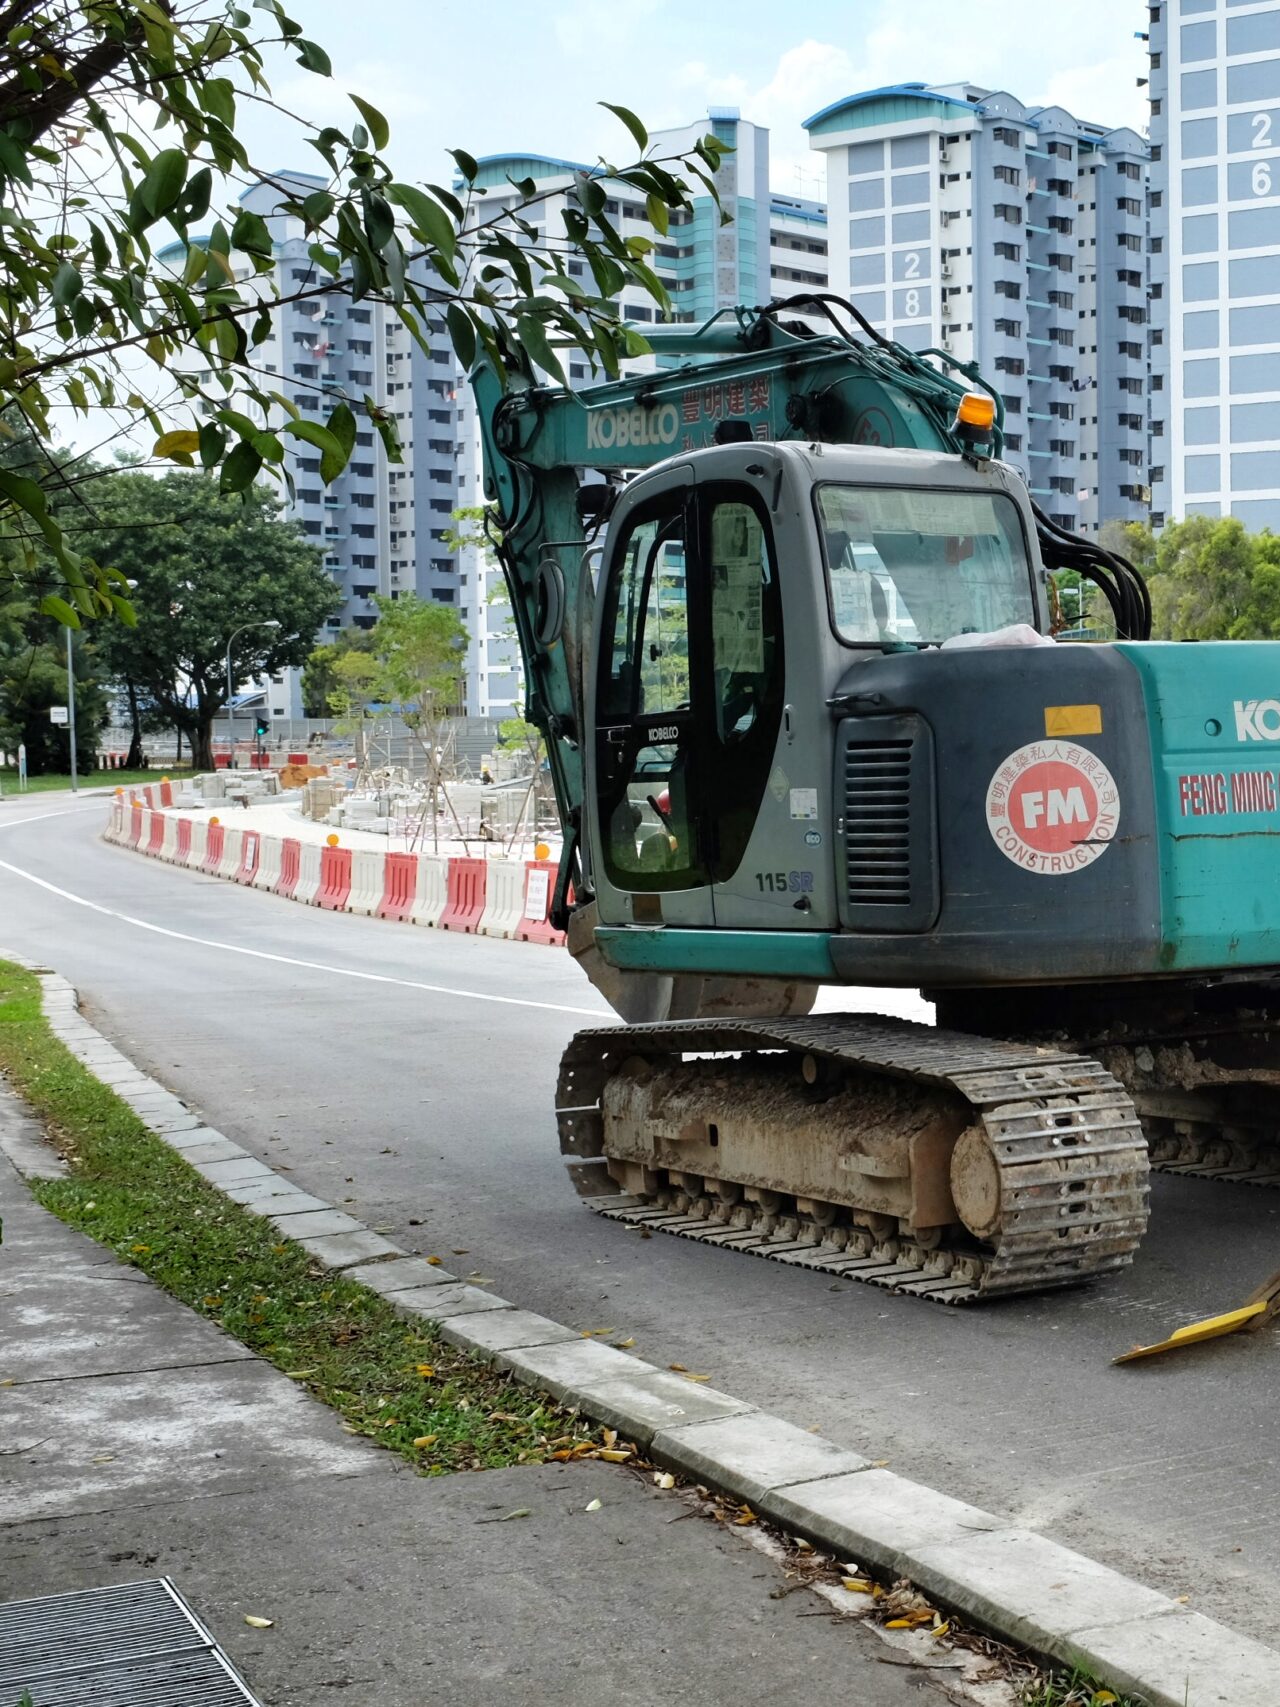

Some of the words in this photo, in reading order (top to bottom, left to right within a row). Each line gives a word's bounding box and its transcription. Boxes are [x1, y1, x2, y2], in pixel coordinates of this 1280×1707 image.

[587, 404, 678, 449] KOBELCO
[648, 726, 679, 741] KOBELCO
[1021, 786, 1090, 829] FM
[1179, 773, 1227, 816] FENG
[1231, 770, 1276, 813] MING
[996, 813, 1115, 871] CONSTRUCTON
